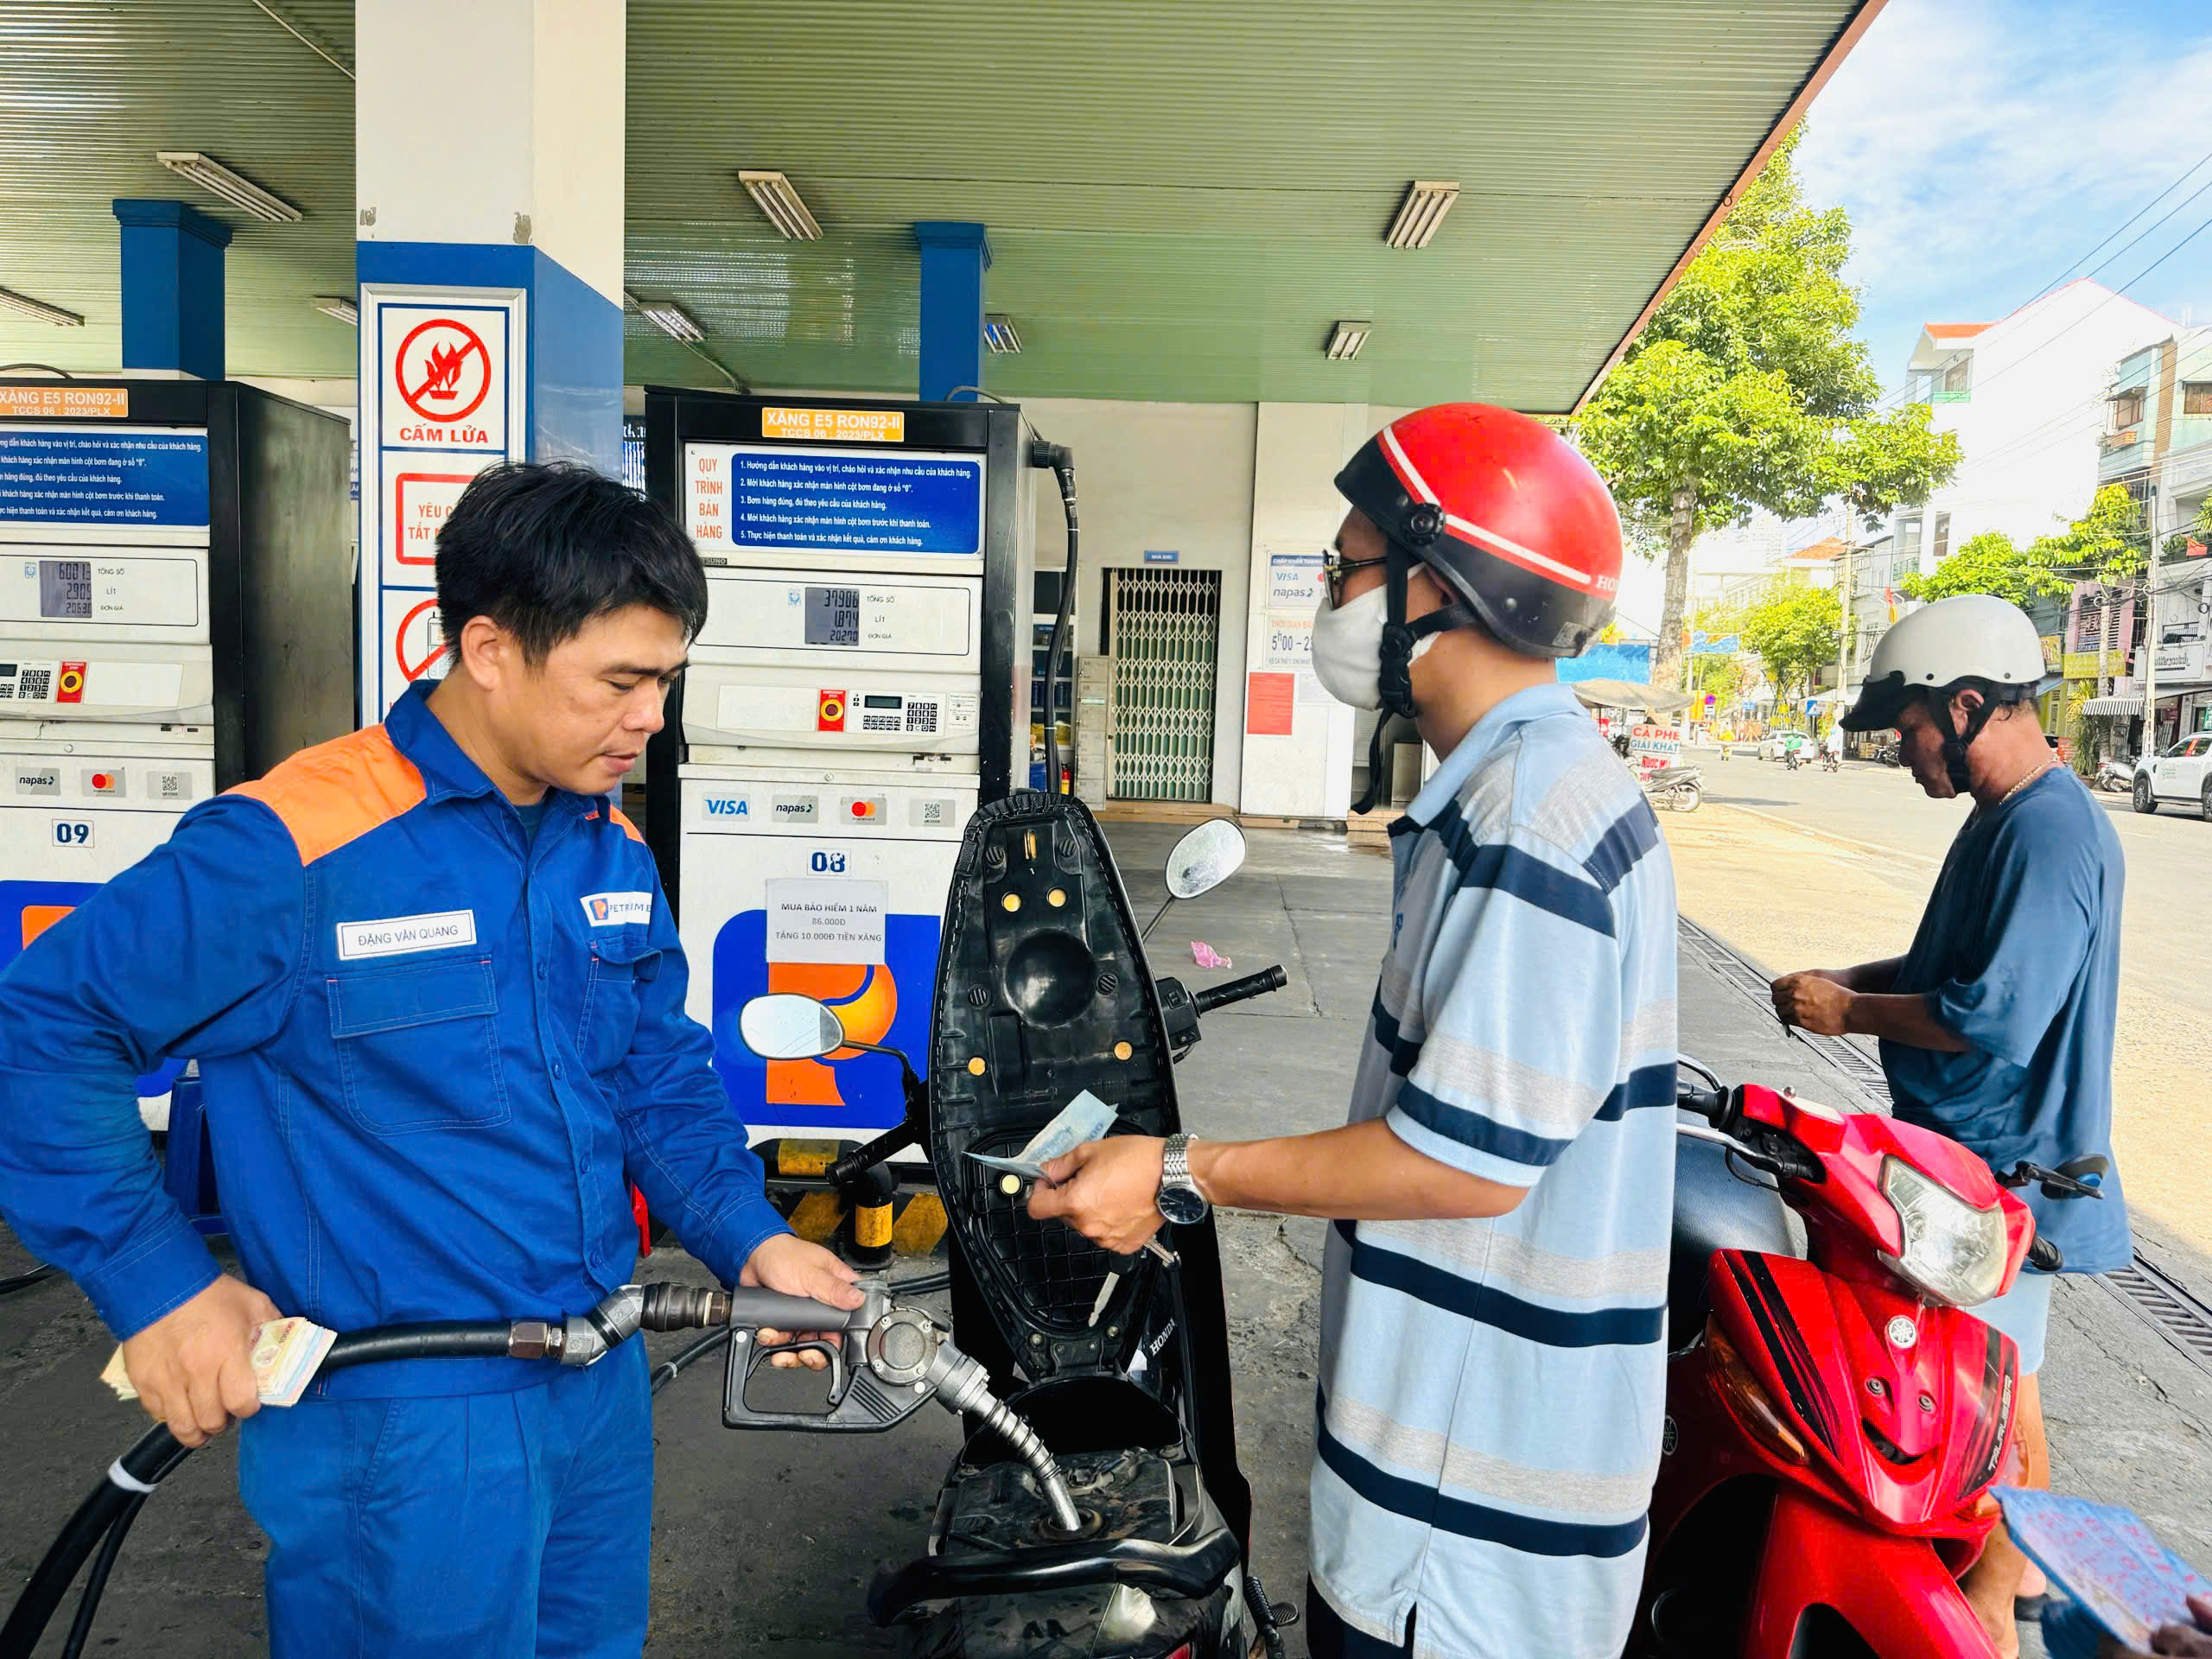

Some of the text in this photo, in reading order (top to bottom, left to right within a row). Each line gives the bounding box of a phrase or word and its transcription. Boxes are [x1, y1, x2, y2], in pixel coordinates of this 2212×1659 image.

[0, 390, 125, 405] XĂNG E5 RON92-II
[12, 406, 41, 415] TCCS
[64, 407, 111, 416] 2023/PLX
[767, 410, 899, 429] XĂNG E5 RON92-II
[399, 423, 488, 443] CẤM LỬA
[781, 429, 810, 437] TCCS
[814, 429, 826, 437] 06
[836, 429, 885, 441] 2023/PLX
[699, 459, 717, 474] QUY
[696, 477, 723, 494] TRÌNH
[418, 502, 442, 518] YÊU
[699, 499, 719, 517] BÁN
[408, 521, 430, 539] TẮT
[696, 521, 722, 539] HÀNG
[1273, 588, 1305, 599] napas
[830, 630, 858, 641] 20270
[1633, 726, 1650, 737] CÀ
[1631, 738, 1680, 752] GIẢI KHÁT
[19, 777, 48, 786] napas
[705, 799, 747, 815] VISA
[776, 804, 804, 814] napas
[57, 823, 89, 843] 09
[811, 852, 845, 873] 08
[804, 902, 823, 911] BẢO
[824, 902, 847, 912] HIỂM
[856, 904, 877, 912] NĂM
[359, 925, 458, 946] ĐẶNG VĂN QUANG
[838, 932, 855, 941] TIỀN
[858, 933, 881, 942] XĂNG
[1149, 1318, 1177, 1356] HONDA
